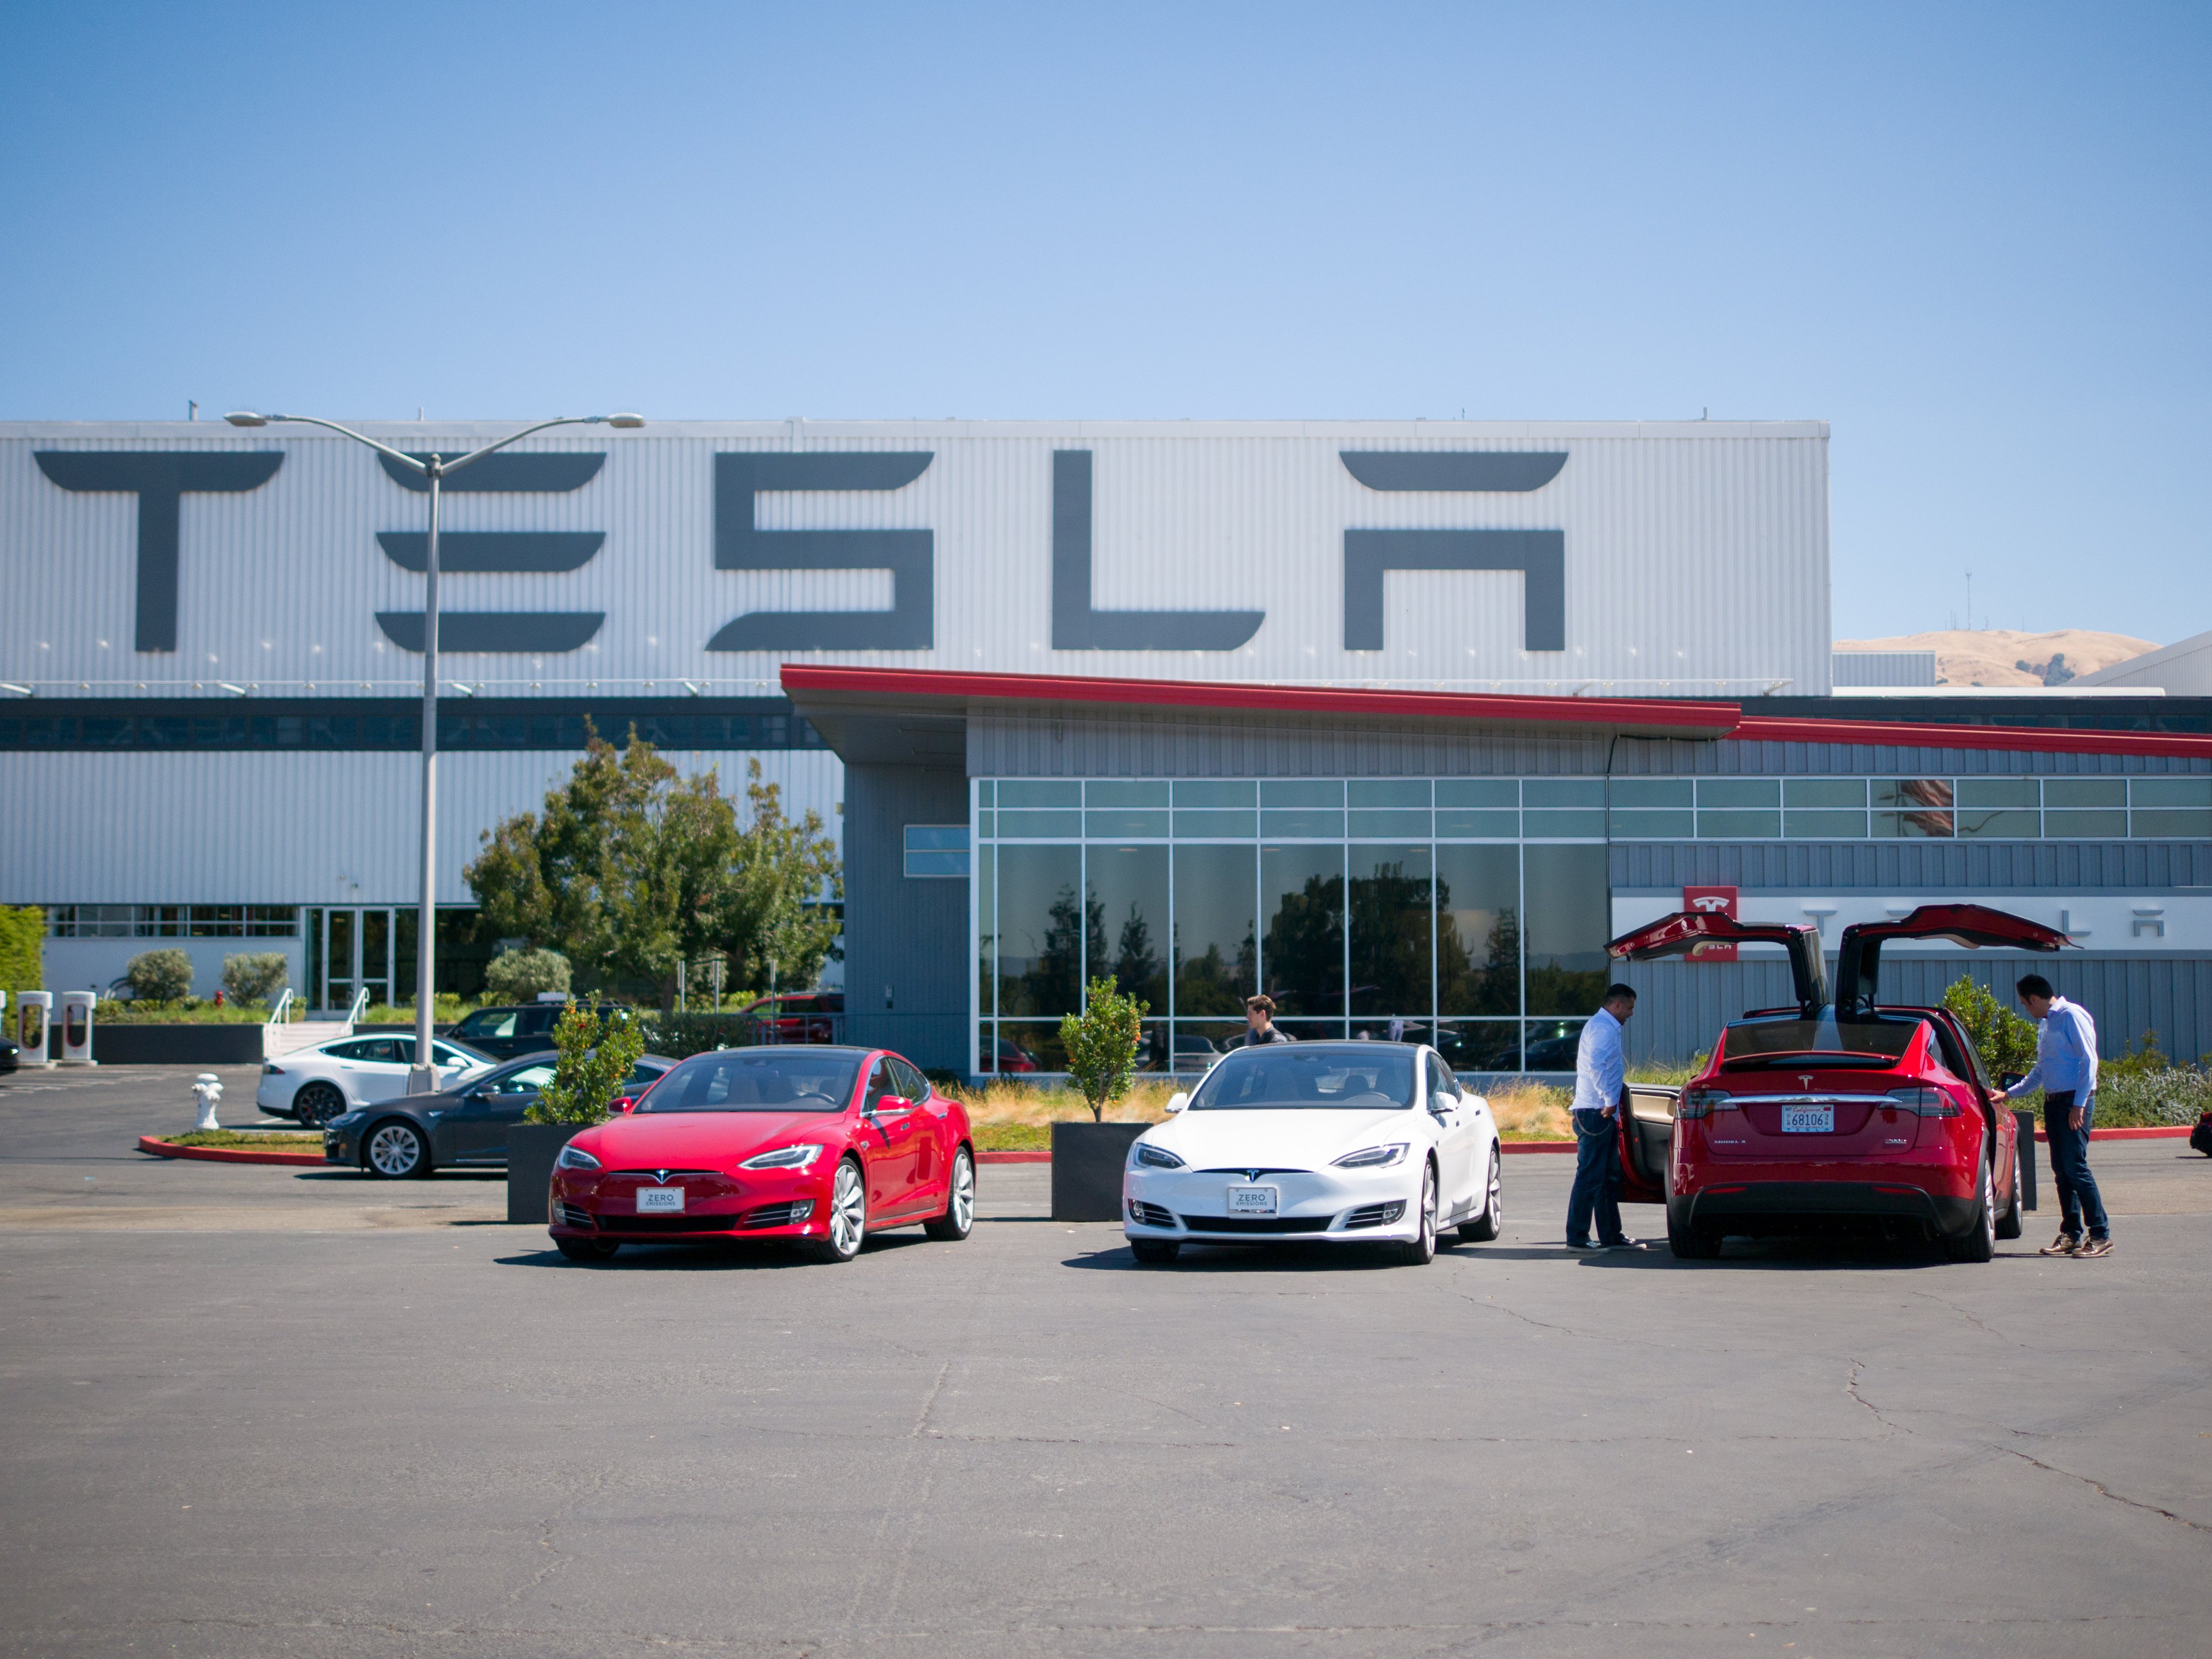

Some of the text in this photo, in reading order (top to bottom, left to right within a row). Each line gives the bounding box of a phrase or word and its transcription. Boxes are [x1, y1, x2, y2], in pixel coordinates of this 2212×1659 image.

[33, 449, 1569, 652] TESLA
[1804, 910, 2164, 937] TLA
[1793, 1105, 1824, 1113] California
[1792, 1113, 1823, 1126] 68106
